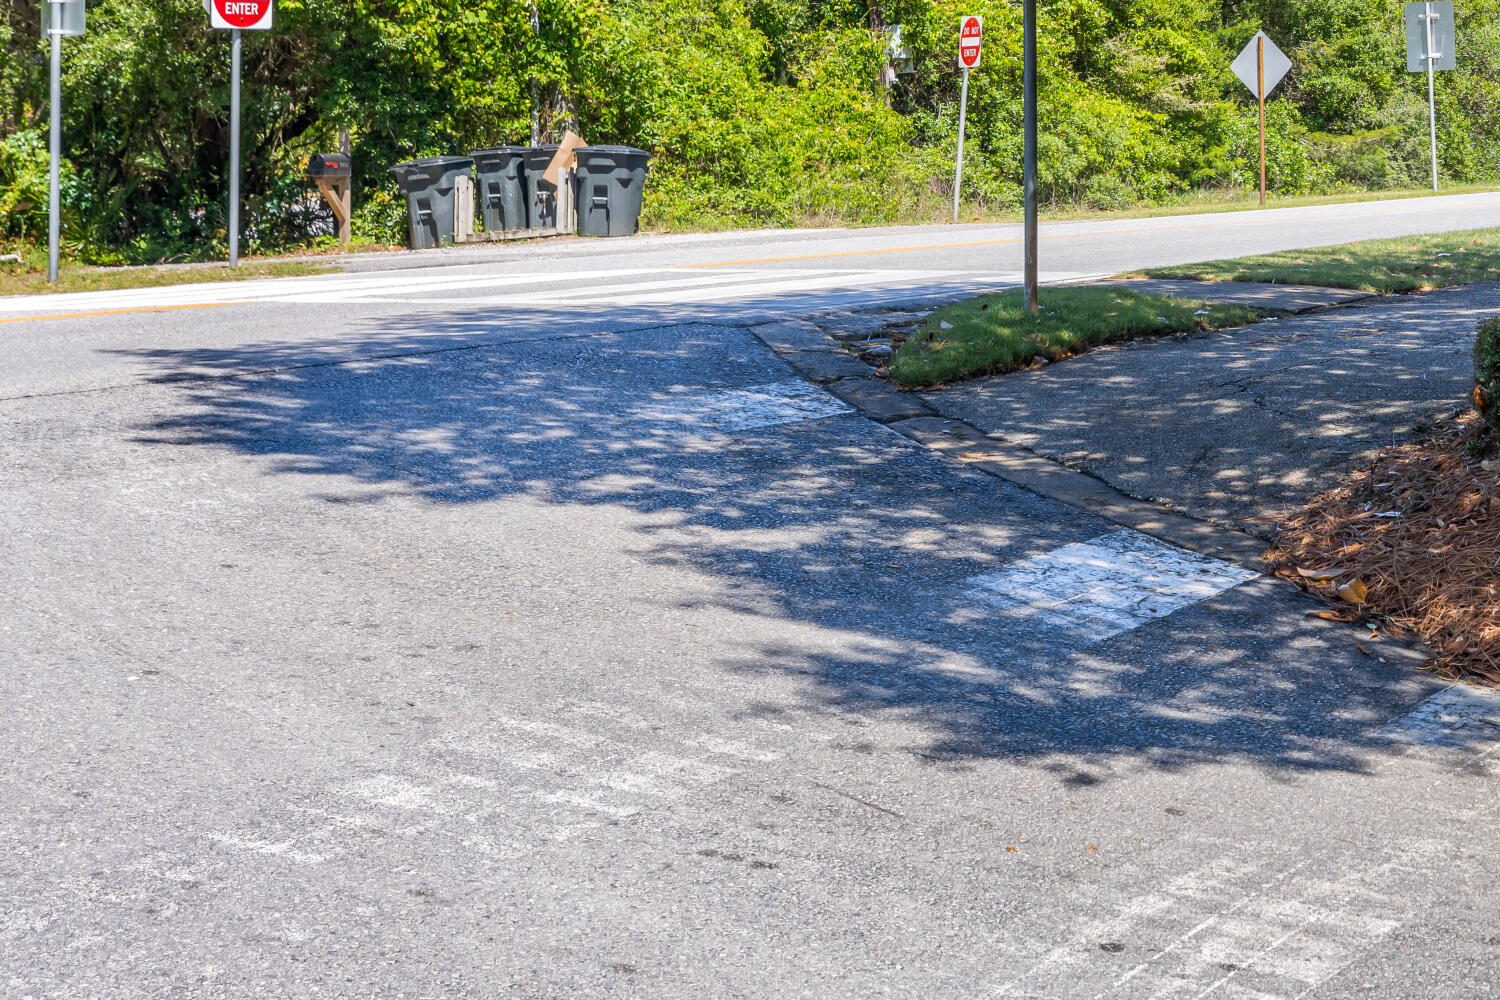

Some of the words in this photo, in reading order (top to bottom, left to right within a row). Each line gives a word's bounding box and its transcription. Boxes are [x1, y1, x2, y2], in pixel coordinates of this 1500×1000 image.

[225, 1, 259, 16] ENTER
[964, 27, 970, 35] DO
[971, 26, 979, 34] NOT
[964, 49, 977, 57] ENTER
